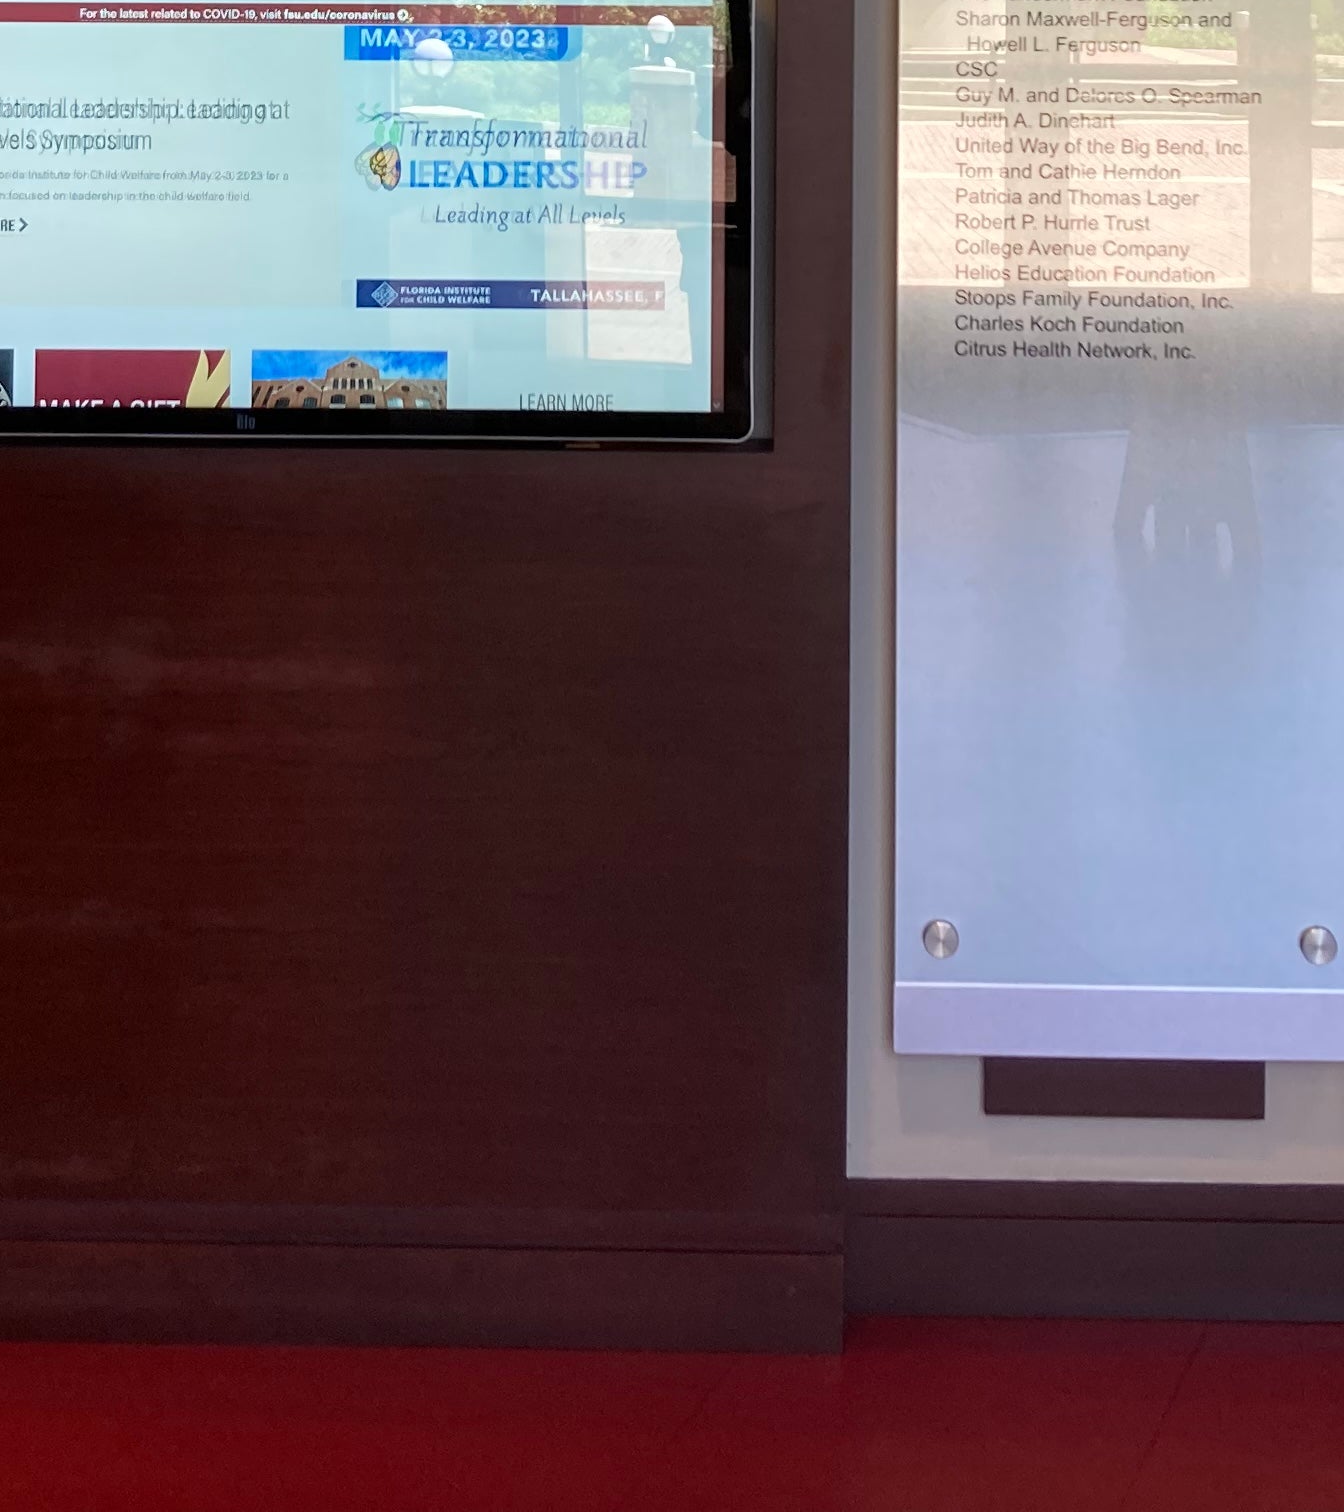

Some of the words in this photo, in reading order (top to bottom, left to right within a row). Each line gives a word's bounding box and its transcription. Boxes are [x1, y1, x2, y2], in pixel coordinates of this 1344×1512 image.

[80, 8, 97, 19] For
[100, 8, 117, 19] the
[119, 8, 149, 19] latest
[150, 8, 188, 19] related
[189, 9, 201, 19] to
[203, 8, 258, 21] COVID-19,
[260, 8, 282, 20] visit
[283, 8, 395, 21] fsu.edu/coronavirus
[360, 28, 420, 47] MAY
[410, 160, 648, 189] LEADERSHIP
[435, 204, 508, 231] Leading
[515, 209, 532, 224] at
[538, 205, 562, 224] All
[570, 205, 626, 225] Levels
[400, 286, 441, 295] FLORIDA
[444, 286, 491, 295] INSTITUTE
[416, 296, 446, 304] CHILD
[448, 296, 491, 304] WELFARE
[531, 288, 648, 304] TALLAHASSEE,
[954, 314, 1024, 332] Charles
[1030, 315, 1076, 332] Koch
[1082, 316, 1184, 334] Foundation
[954, 339, 1007, 358] Citrus
[1013, 340, 1072, 358] Health
[1077, 341, 1158, 361] Network,
[1164, 342, 1196, 360] Inc.
[519, 393, 567, 411] LEARN
[572, 393, 614, 412] MORE
